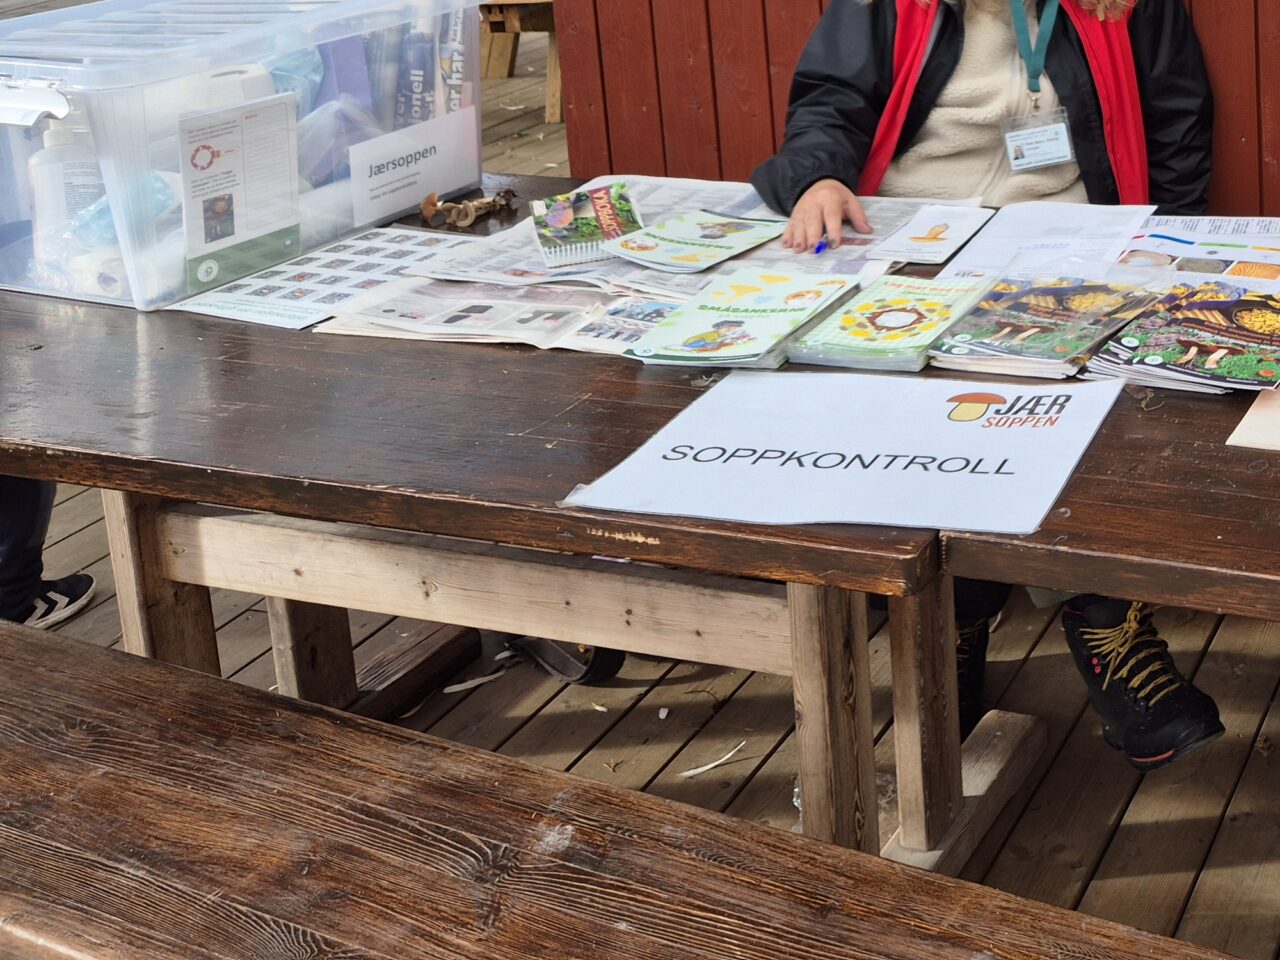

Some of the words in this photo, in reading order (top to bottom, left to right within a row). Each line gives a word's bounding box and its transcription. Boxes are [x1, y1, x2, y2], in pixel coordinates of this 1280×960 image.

[368, 143, 437, 179] Jærsoppen
[697, 302, 807, 315] SMÅSANKERNE
[995, 394, 1073, 416] JÆR
[980, 414, 1060, 429] SOPPEN
[662, 444, 1017, 476] SOPPKONTROLL
